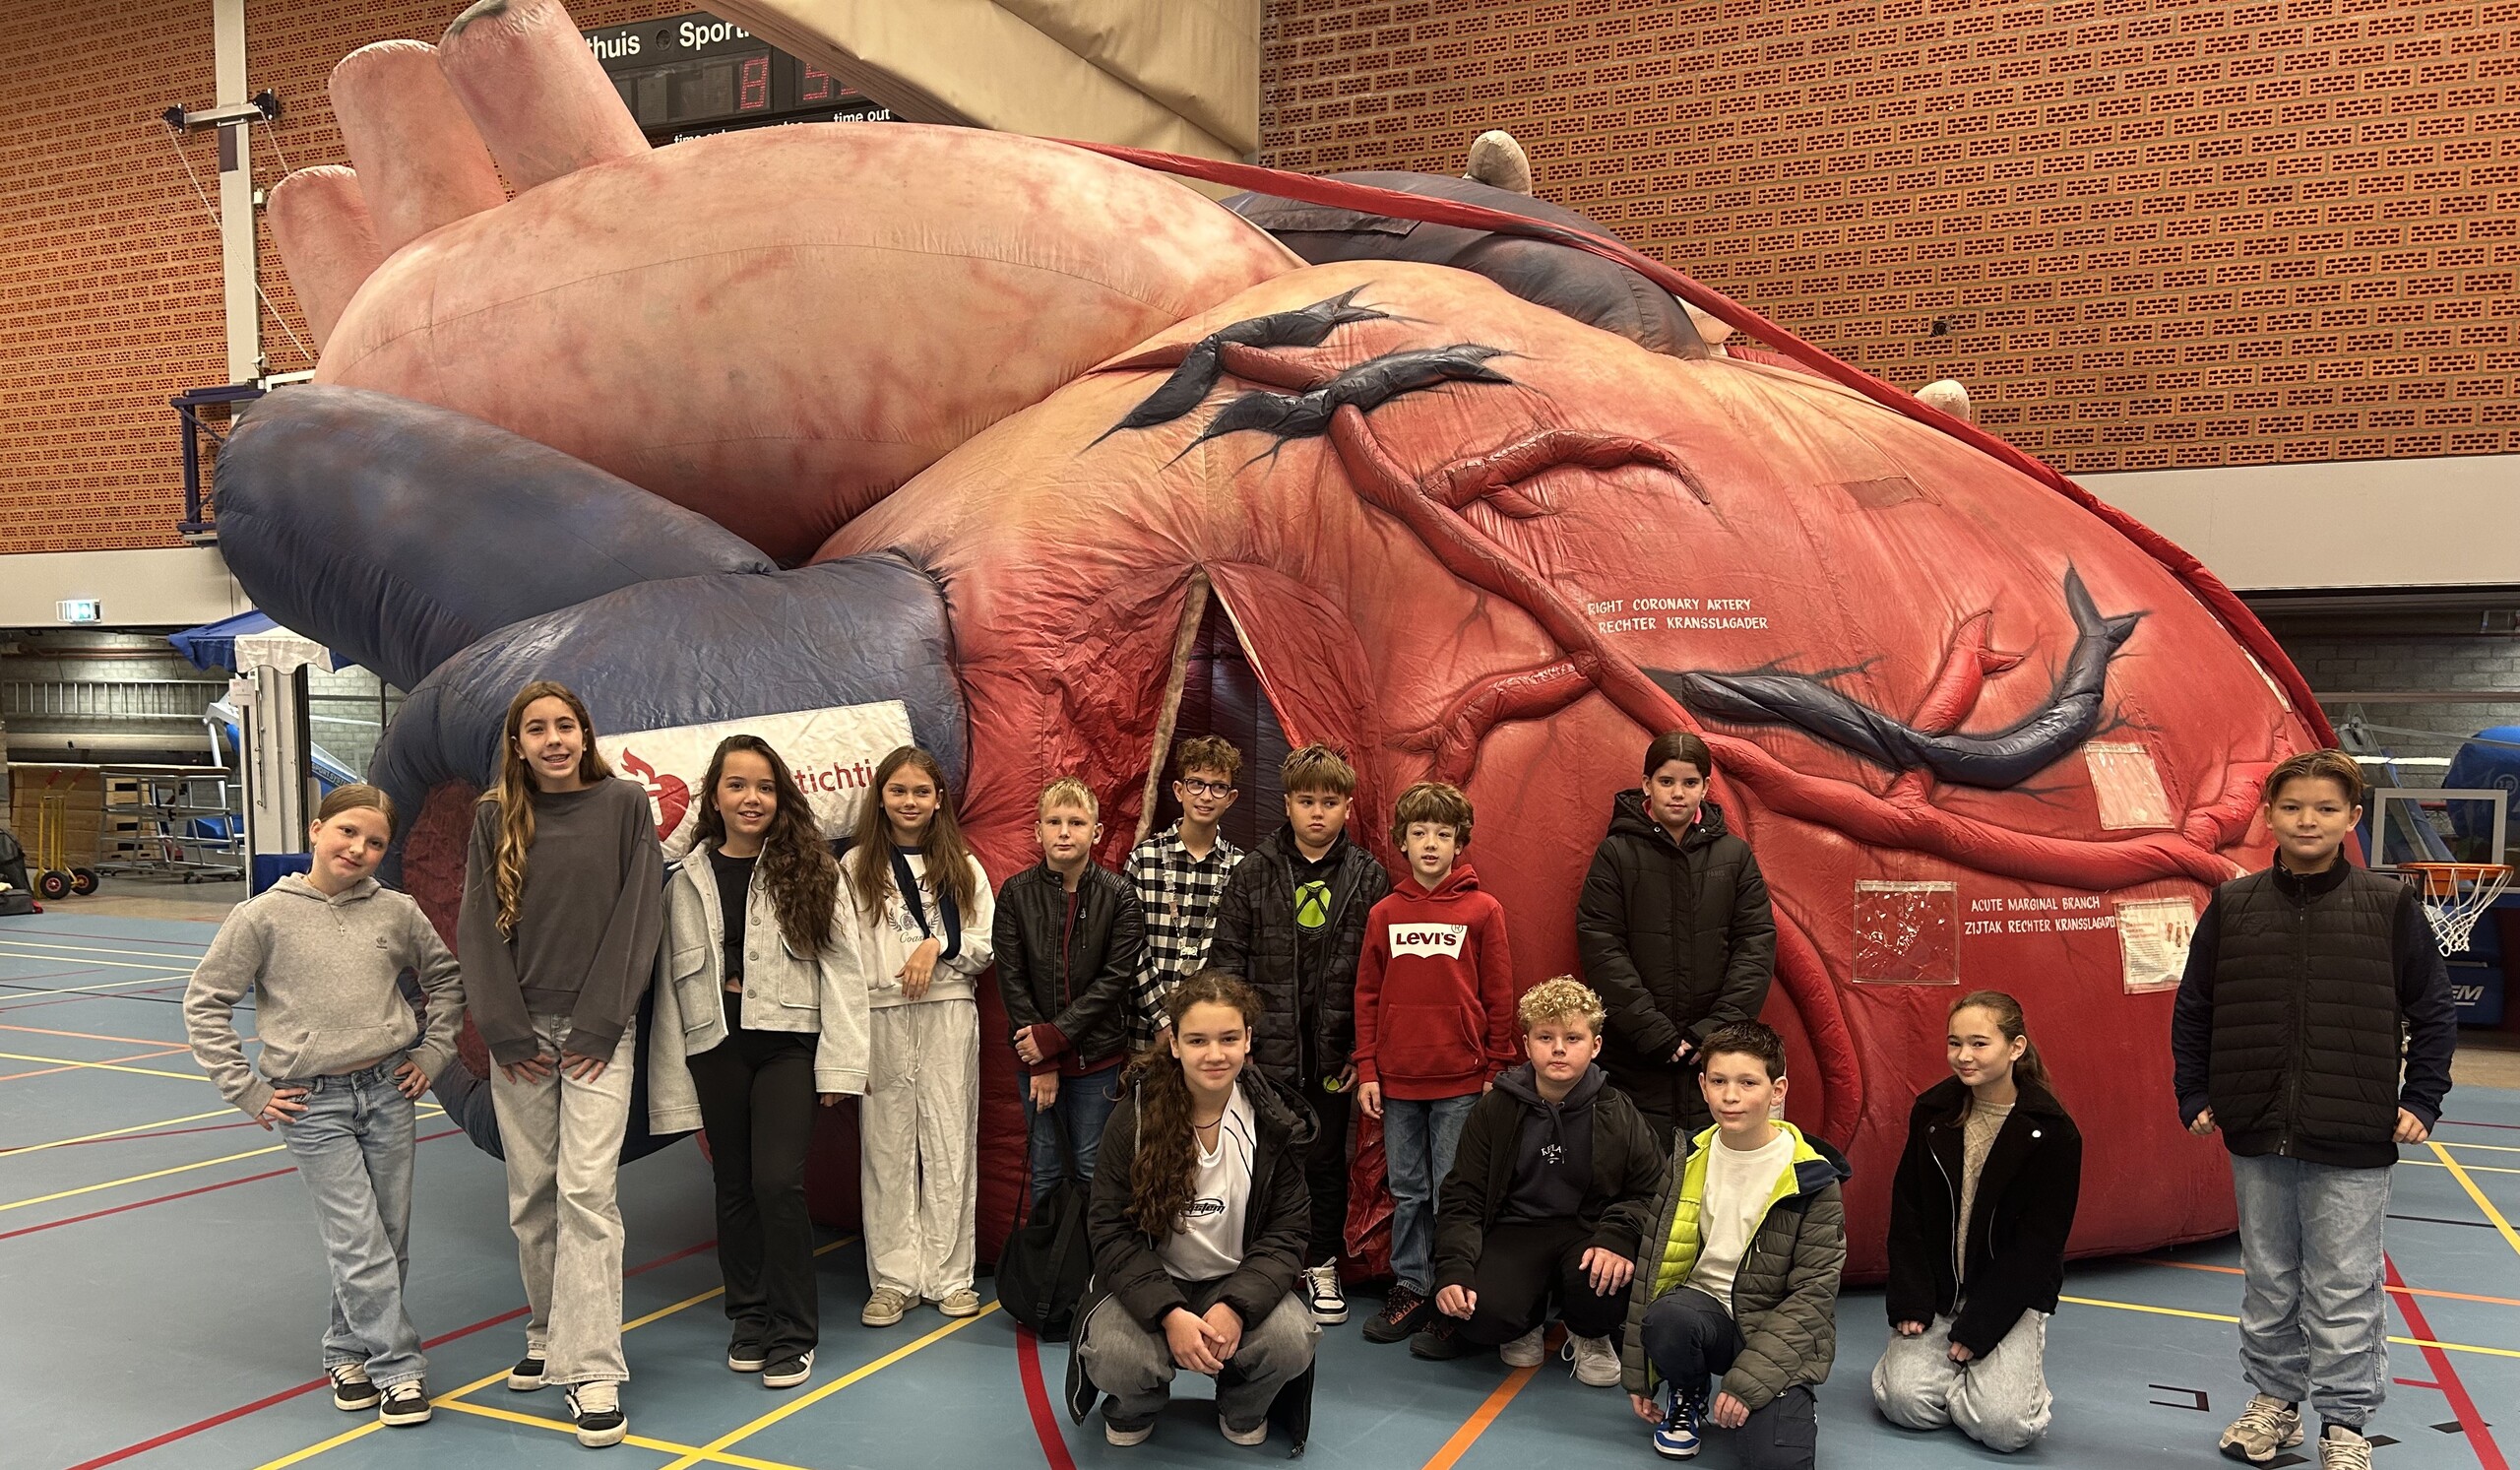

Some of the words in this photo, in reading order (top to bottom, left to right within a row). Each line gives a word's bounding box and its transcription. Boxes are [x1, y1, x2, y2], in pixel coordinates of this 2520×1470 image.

[679, 22, 750, 51] Sport
[834, 112, 864, 123] time
[867, 108, 891, 122] out
[1587, 600, 1624, 616] RIGHT
[1632, 598, 1700, 611] CORONARY
[1707, 599, 1751, 611] ARTERY
[1598, 617, 1657, 635] RECHTER
[1666, 616, 1769, 630] KRANSSLAGADER
[793, 758, 878, 796] tichti
[1971, 898, 2003, 913] ACUTE
[2007, 897, 2058, 911] MARGINAL
[2062, 895, 2101, 911] BRANCH
[1964, 921, 2003, 935] ZIJTAK
[2008, 920, 2051, 933] RECHTER
[900, 931, 924, 943] Coas
